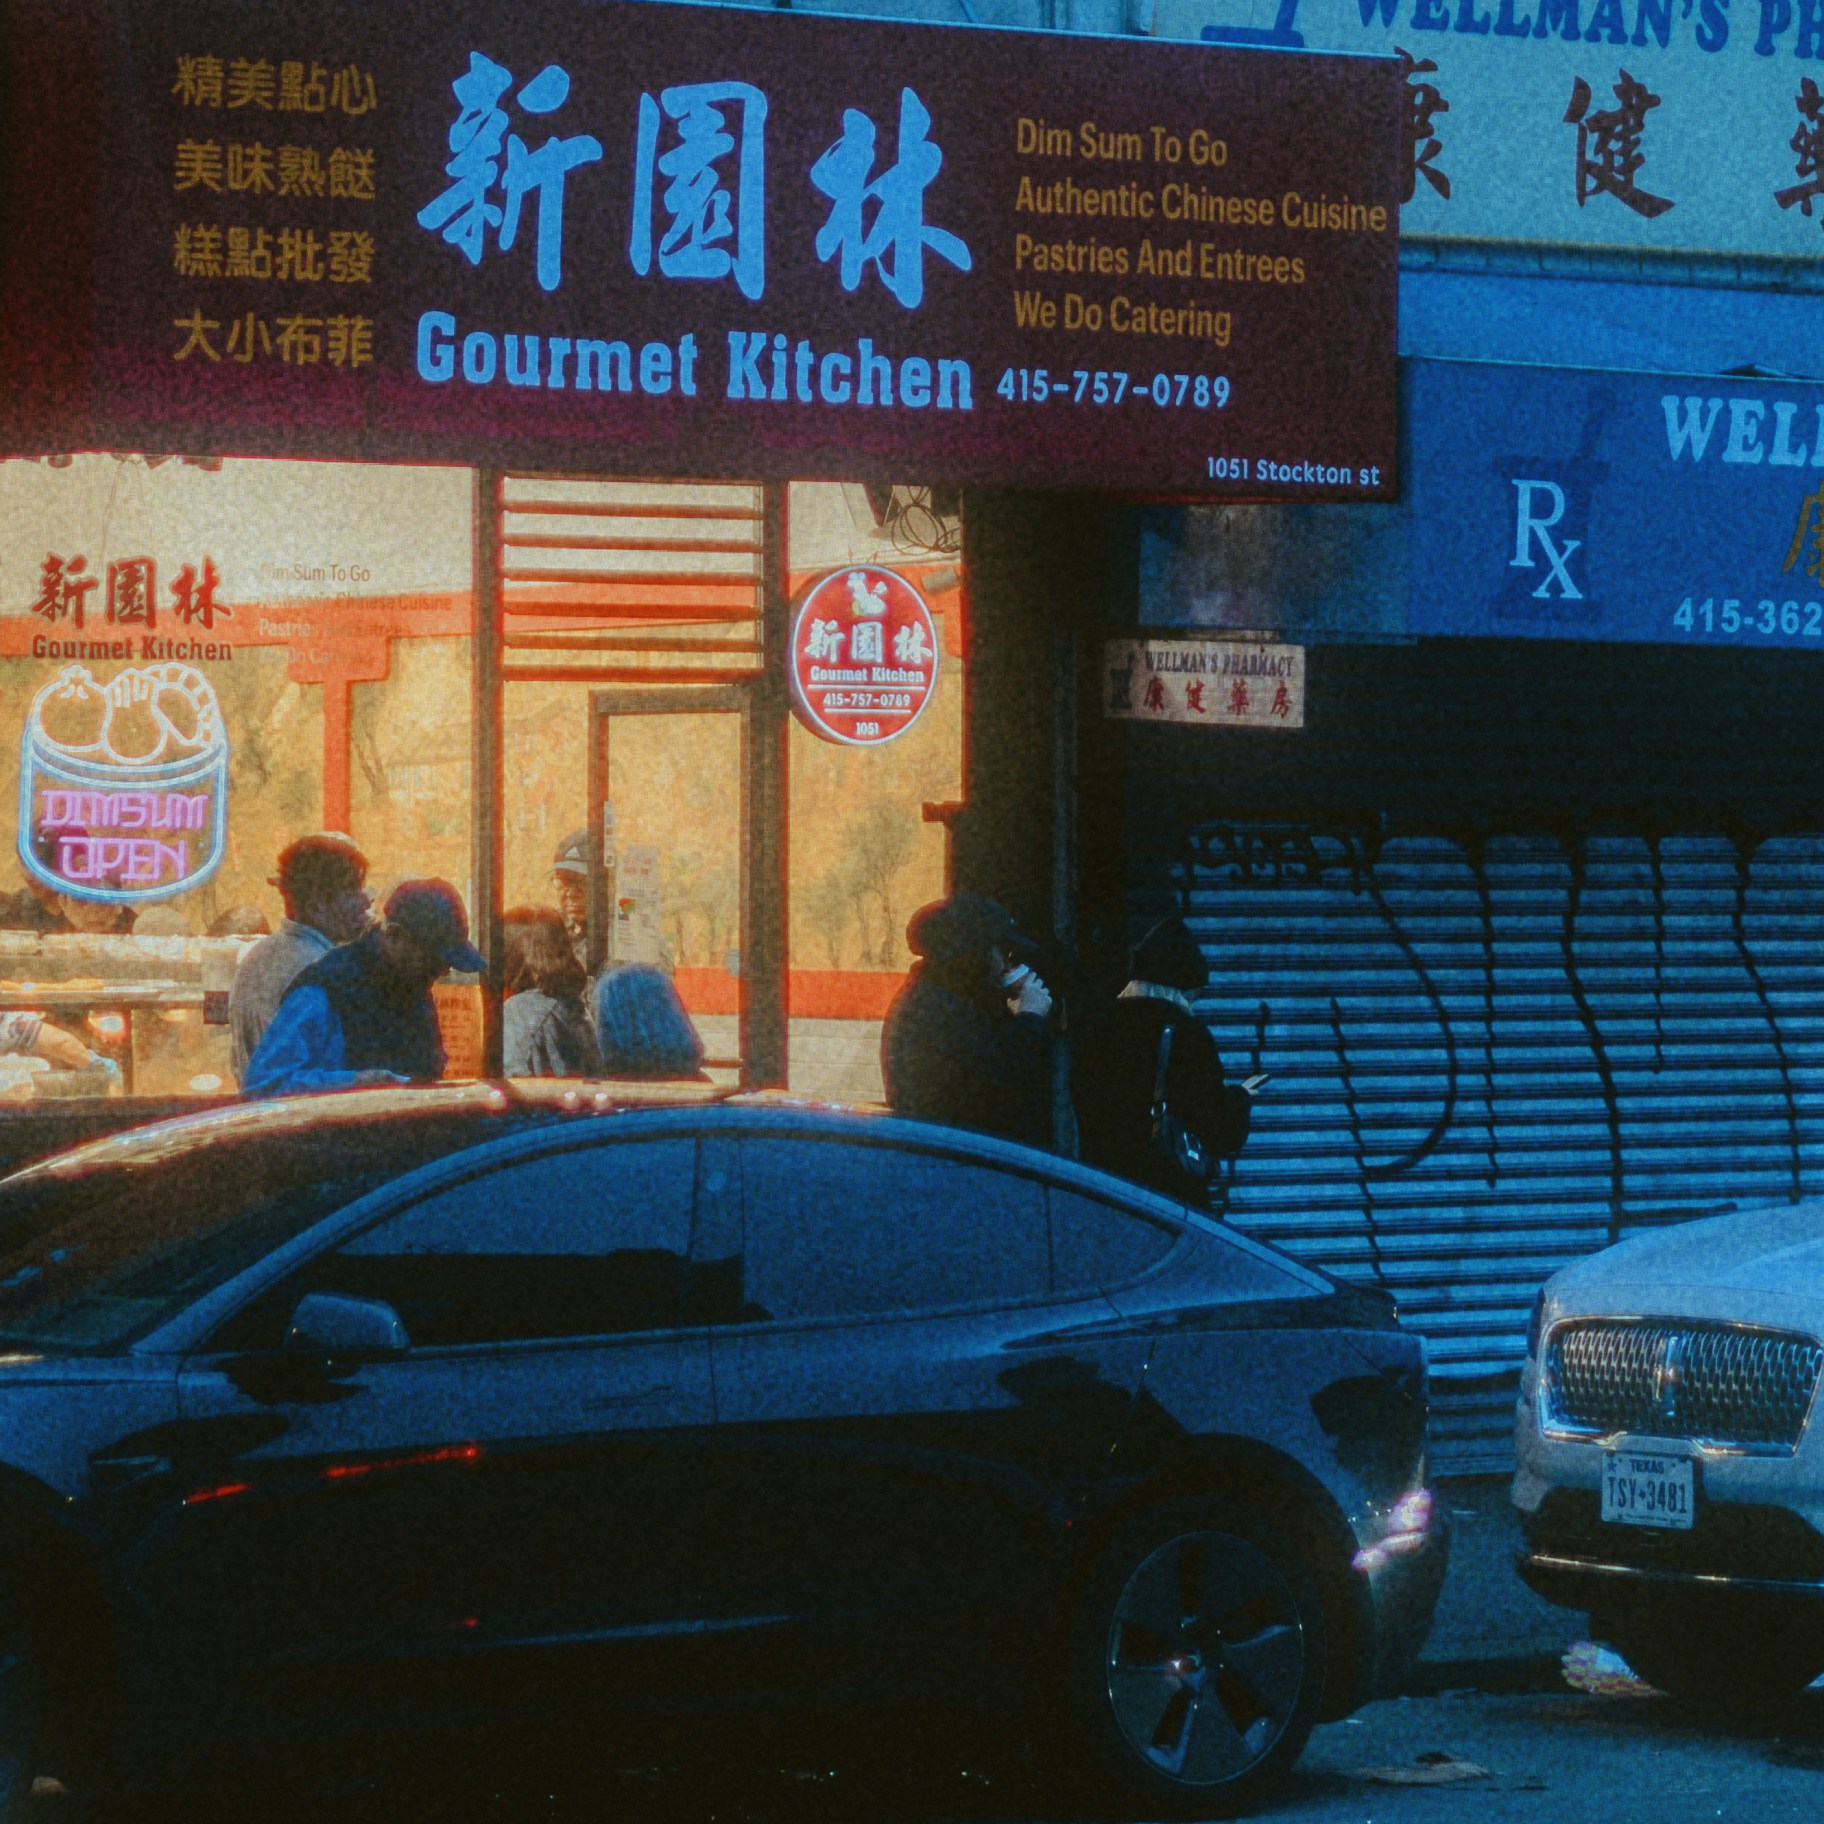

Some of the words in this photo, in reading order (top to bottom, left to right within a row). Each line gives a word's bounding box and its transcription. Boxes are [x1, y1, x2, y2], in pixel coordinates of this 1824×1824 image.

[172, 52, 377, 115] 精美點心
[1017, 118, 1072, 157] Dim
[1079, 122, 1142, 162] Sum
[1150, 126, 1182, 164] To
[1189, 129, 1228, 168] Go
[417, 51, 972, 309] 新園林
[1015, 176, 1155, 219] Authentic
[1161, 183, 1275, 227] Chinese
[1281, 191, 1388, 233] Cuisine
[173, 223, 376, 284] 糕點批發
[1015, 233, 1129, 275] Pastries
[1136, 240, 1193, 278] And
[1199, 243, 1305, 284] Entrees
[173, 308, 375, 368] 大小布菲
[1013, 290, 1057, 329] We
[1064, 293, 1103, 332] Do
[1110, 295, 1232, 347] Catering
[417, 310, 698, 396] Gourmet
[727, 330, 972, 410] Kitchen
[996, 367, 1231, 408] 415-757-0789
[1207, 456, 1250, 479] 1051
[1256, 459, 1352, 485] Stockton
[1359, 465, 1380, 486] st
[293, 563, 325, 582] Sum
[330, 563, 347, 582] To
[349, 564, 372, 583] Go
[32, 634, 134, 661] Gourmet
[141, 635, 233, 662] Kitchen
[1144, 649, 1218, 674] WELLMAN'S
[1222, 652, 1296, 678] PHARMACY
[810, 666, 868, 682] Gourmet
[871, 667, 925, 683] Kitchen
[57, 835, 188, 881] OPEN
[1629, 1458, 1665, 1475] TEXAS
